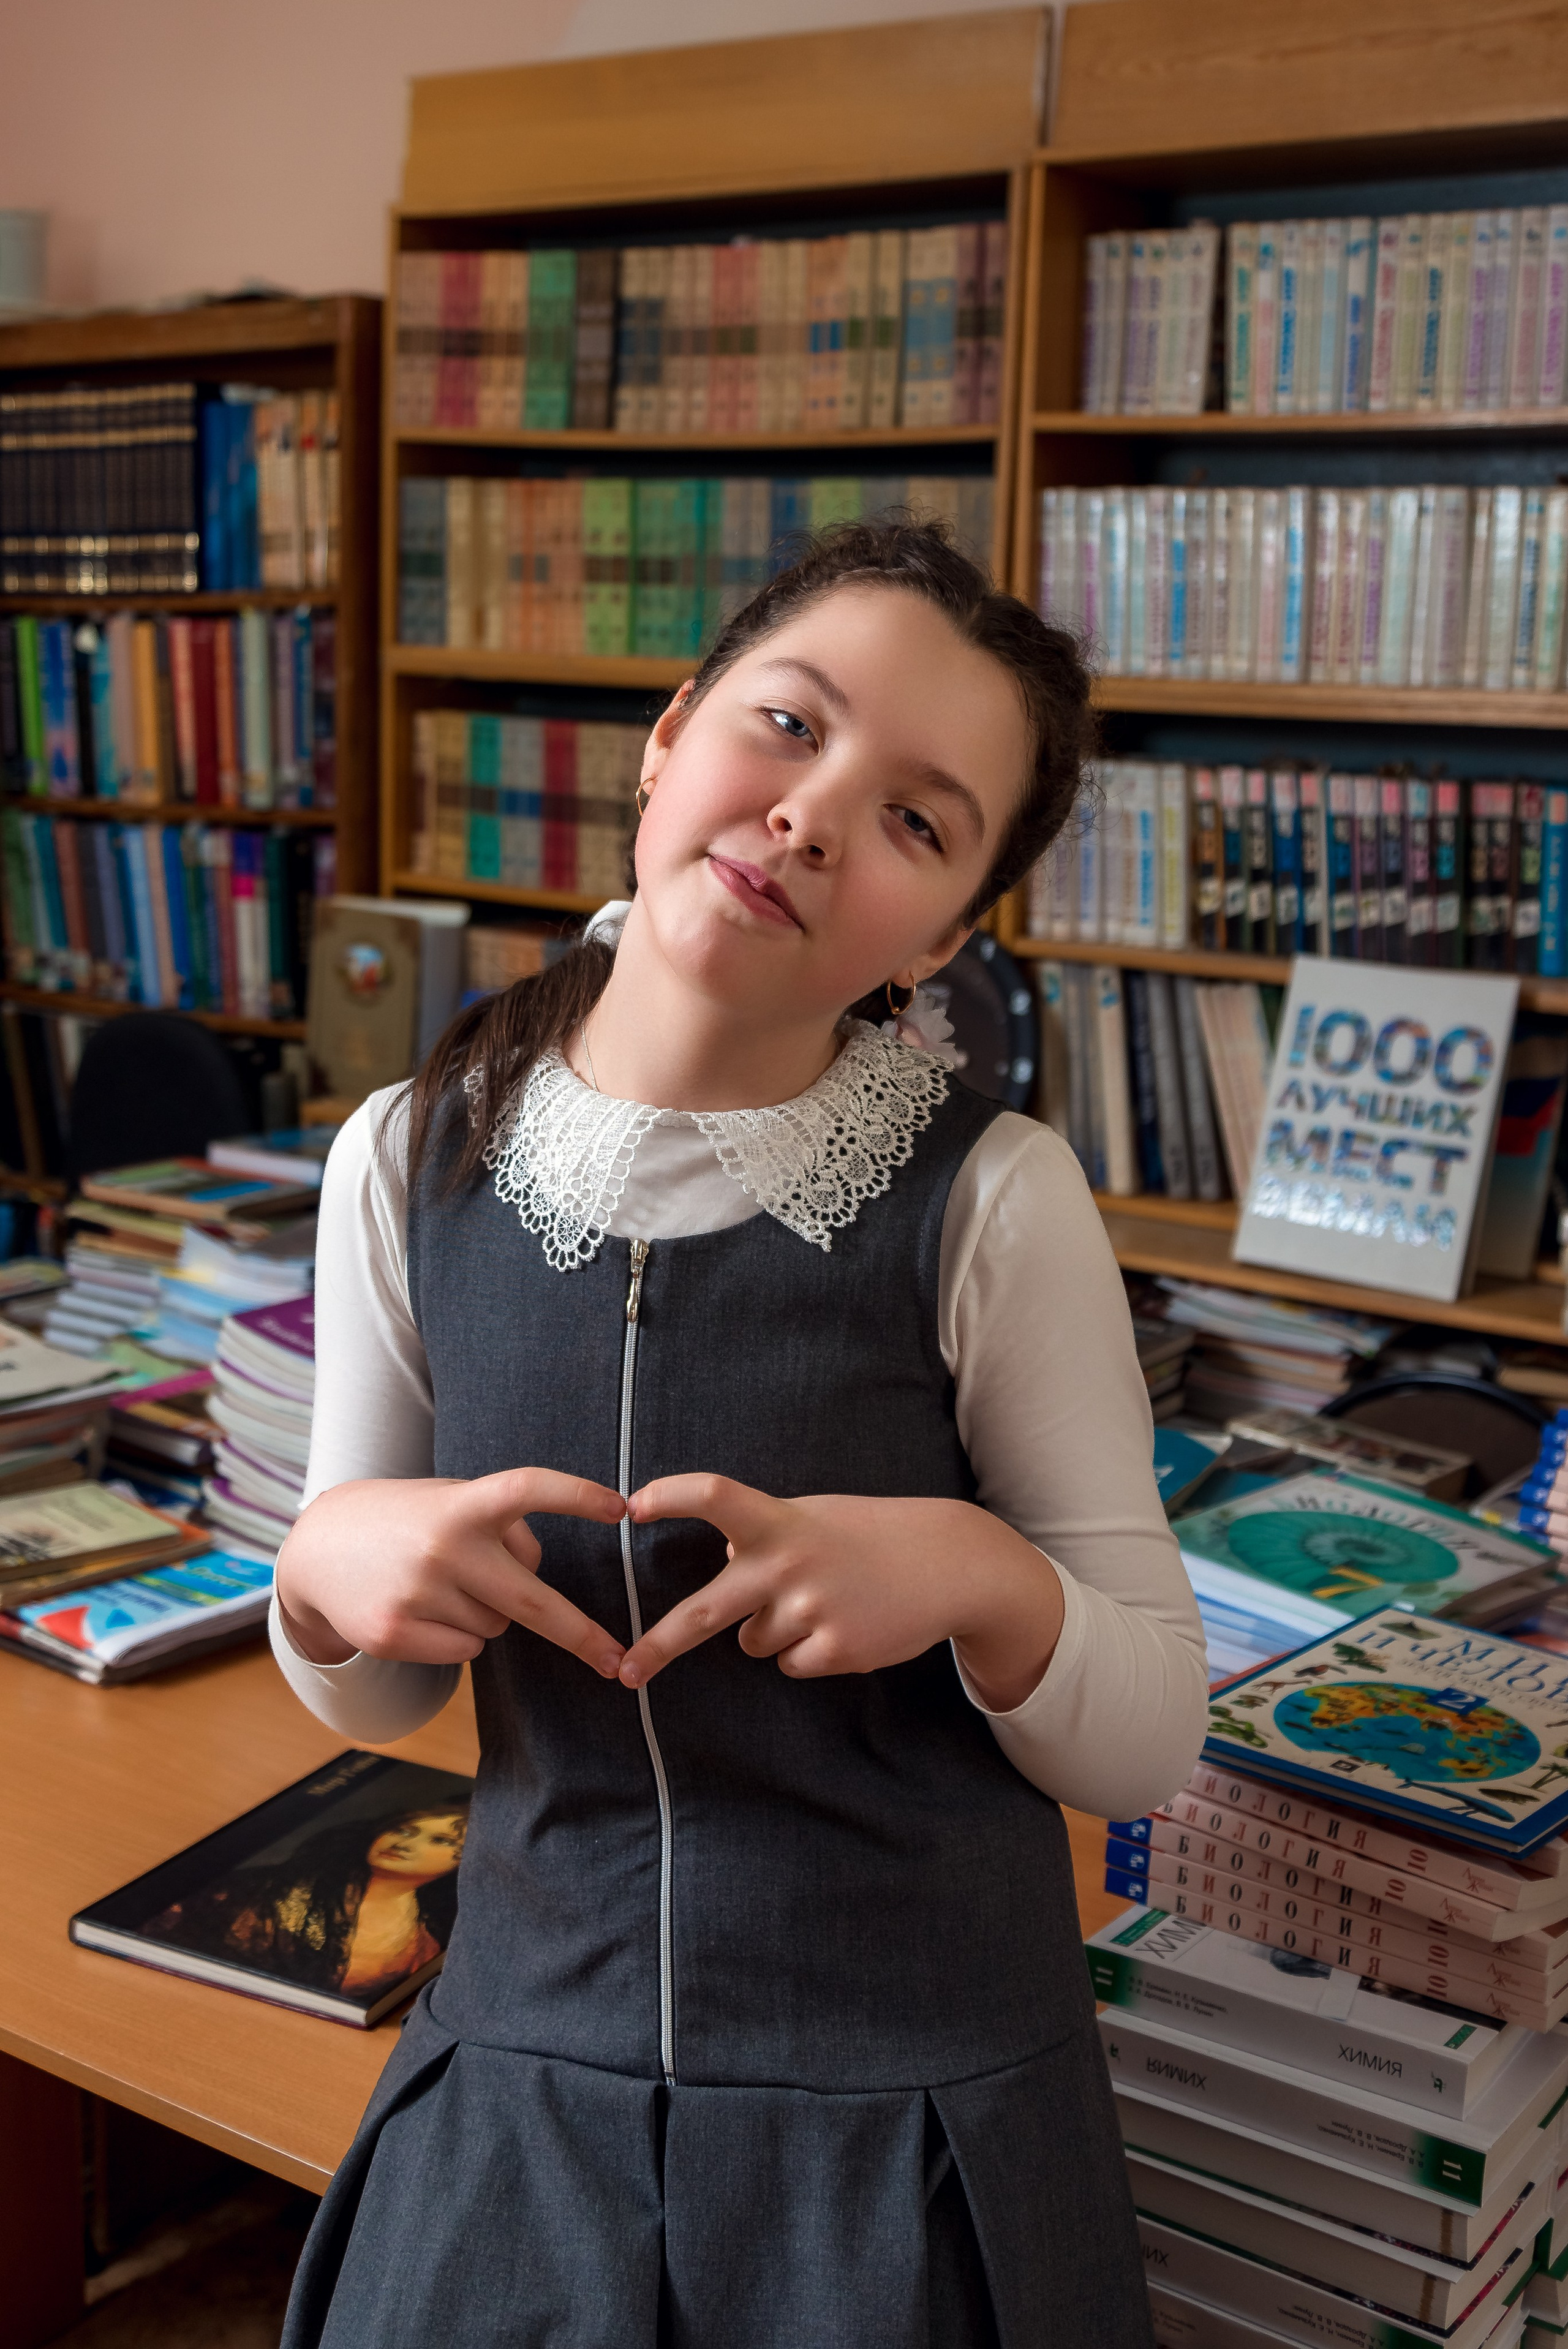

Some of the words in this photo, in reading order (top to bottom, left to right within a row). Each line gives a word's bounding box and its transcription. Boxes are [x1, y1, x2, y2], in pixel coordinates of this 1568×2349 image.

[1289, 1005, 1494, 1095] 1000
[1276, 1077, 1477, 1136] ЛУЧШИХ
[1265, 1119, 1468, 1195] МЕСТ
[1311, 1564, 1384, 1599] 7
[1356, 1631, 1395, 1650] И
[1438, 1690, 1477, 1710] 2
[1188, 1775, 1367, 1850] ИОЛОГИЯ
[1407, 1849, 1428, 1872] 10
[1178, 1834, 1382, 1915] БИОЛОГИЯ
[1385, 1878, 1407, 1902] 10
[1177, 1866, 1382, 1947] БИОЛОГИЯ
[1428, 1945, 1450, 1968] 10
[1175, 1895, 1381, 1977] БИОЛОГИЯ
[1427, 1974, 1449, 1998] 10
[1147, 2056, 1207, 2092] ХИМИЯ
[1338, 2043, 1403, 2079] ХИМИЯ
[1331, 2120, 1354, 2134] Лунин
[1442, 2159, 1463, 2181] 11
